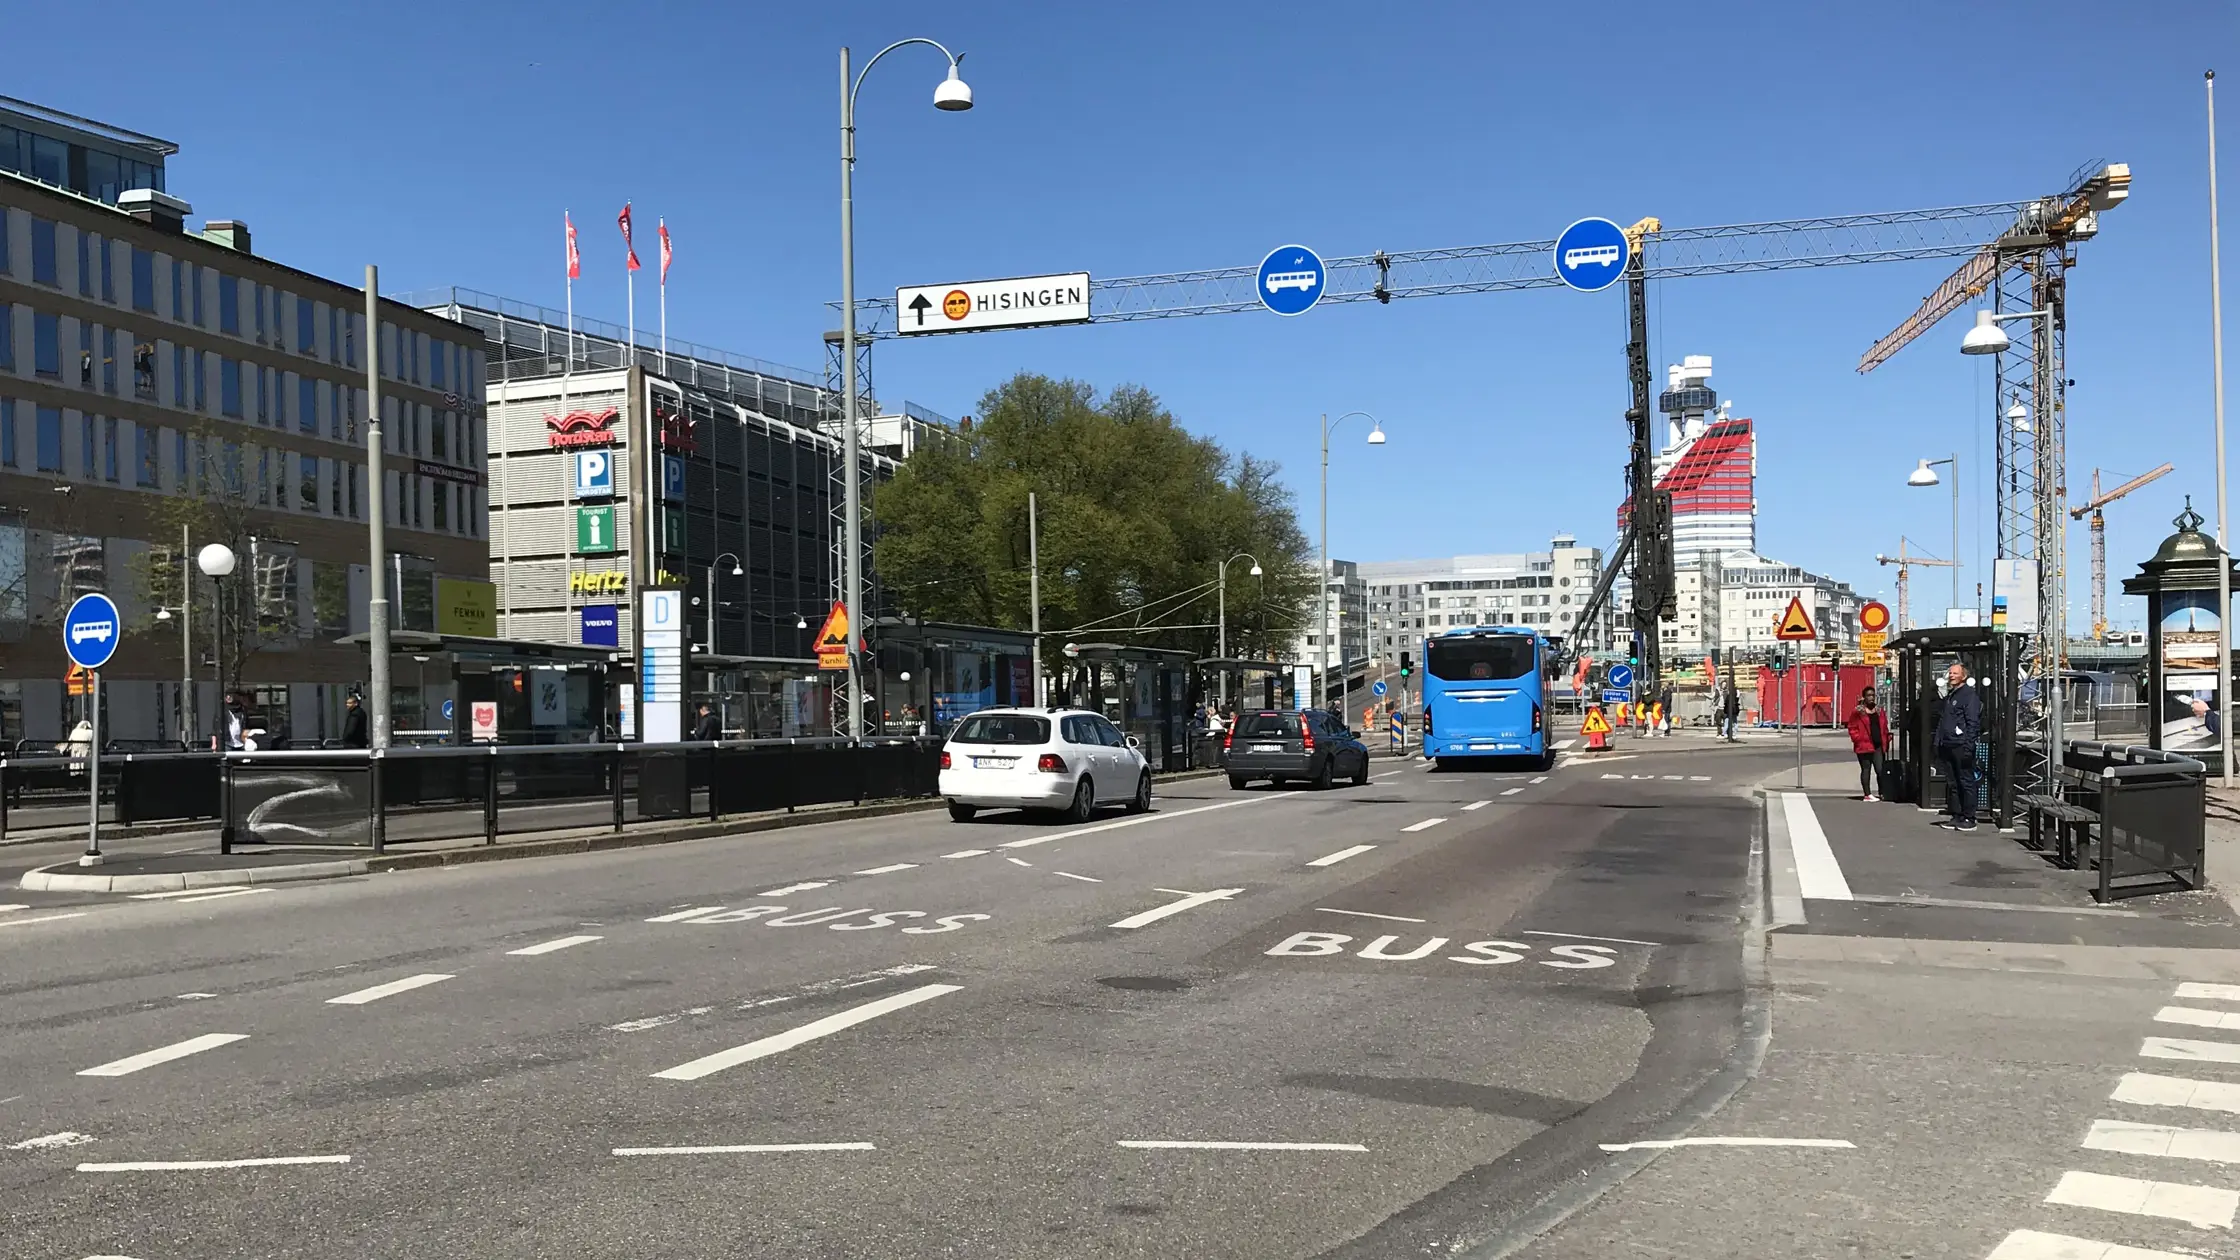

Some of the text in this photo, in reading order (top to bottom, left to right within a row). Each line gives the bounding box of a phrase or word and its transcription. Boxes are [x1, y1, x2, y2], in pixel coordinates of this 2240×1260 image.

[977, 287, 1080, 311] HISINGEN
[580, 453, 605, 487] P
[582, 507, 608, 516] TOURIST
[570, 568, 626, 591] Hertz
[654, 596, 669, 624] D
[585, 619, 613, 627] VOLVO
[997, 758, 1012, 766] 527
[681, 906, 991, 934] BUSS
[1264, 932, 1618, 968] BUSS
